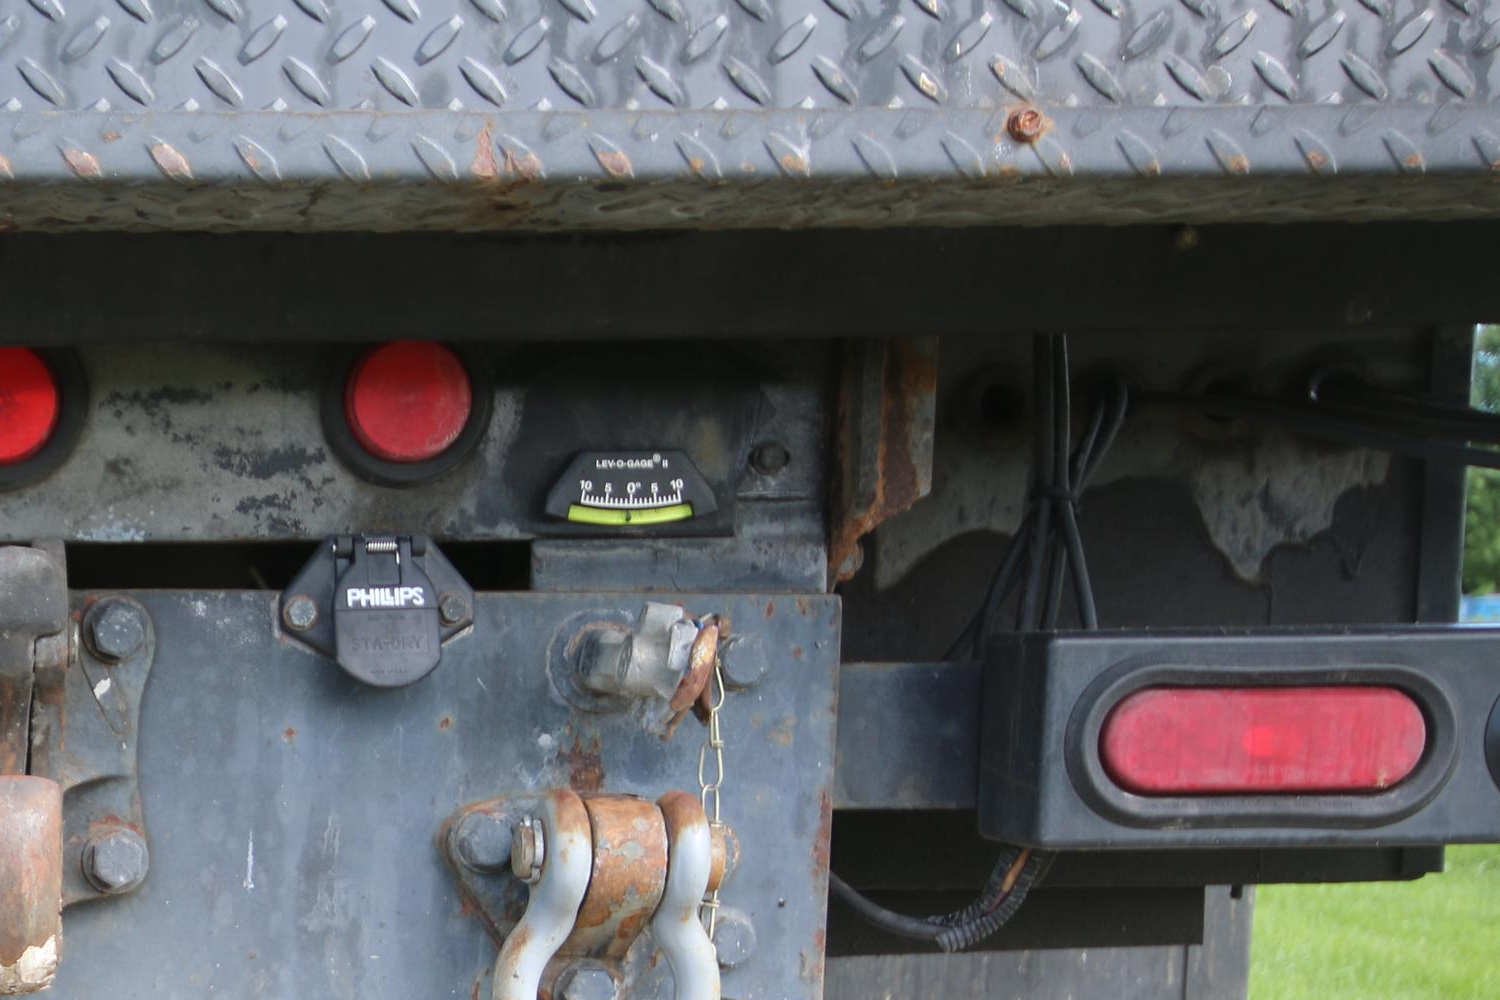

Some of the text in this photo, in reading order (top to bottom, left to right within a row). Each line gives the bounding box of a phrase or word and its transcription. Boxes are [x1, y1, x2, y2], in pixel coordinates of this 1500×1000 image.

[579, 479, 593, 491] 10
[604, 482, 612, 493] 5
[650, 482, 659, 493] 5
[670, 478, 684, 490] 10
[347, 587, 425, 607] PHILLIPS
